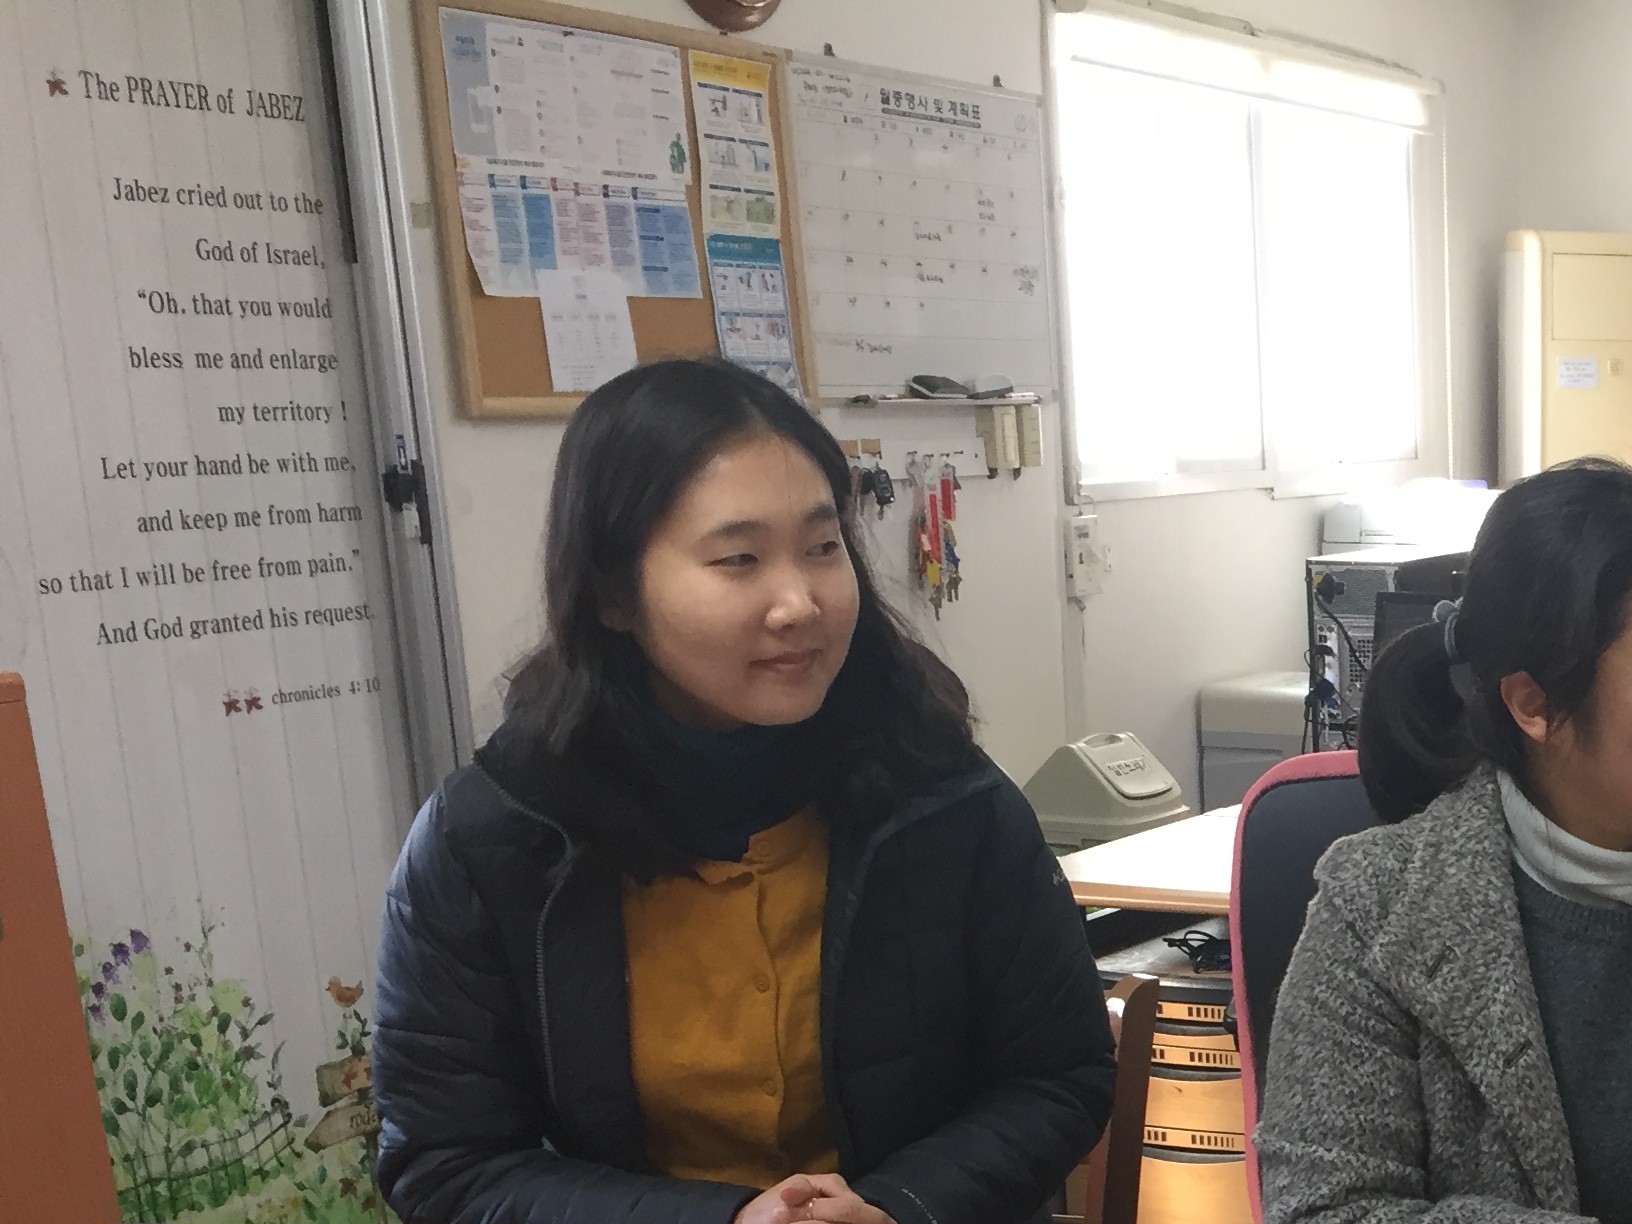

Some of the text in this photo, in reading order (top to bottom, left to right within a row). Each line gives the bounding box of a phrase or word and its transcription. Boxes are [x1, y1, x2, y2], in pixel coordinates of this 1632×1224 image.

[79, 70, 305, 122] The PRAYER of JABEZ
[933, 98, 944, 114] 및
[947, 100, 981, 120] 계획표
[112, 177, 324, 216] Jabez cried out to the
[195, 238, 325, 269] God of Israel,
[192, 293, 233, 317] that
[239, 298, 272, 321] you
[277, 296, 333, 319] would
[128, 346, 339, 376] bless me and enlarge
[217, 405, 246, 425] my
[252, 400, 333, 425] territory
[101, 456, 138, 480] Let
[143, 459, 188, 481] your
[194, 455, 243, 477] hand
[249, 453, 270, 475] be
[275, 452, 319, 474] with
[136, 503, 363, 534] and keep me from harm
[39, 577, 62, 595] so
[69, 568, 114, 594] that
[119, 567, 130, 589] I
[135, 563, 176, 589] will
[181, 561, 207, 583] be
[211, 559, 253, 582] free
[258, 556, 303, 578] from
[96, 621, 139, 646] And
[143, 617, 184, 642] God
[188, 610, 265, 641] granted
[269, 607, 299, 630] his
[270, 682, 342, 706] chronicles
